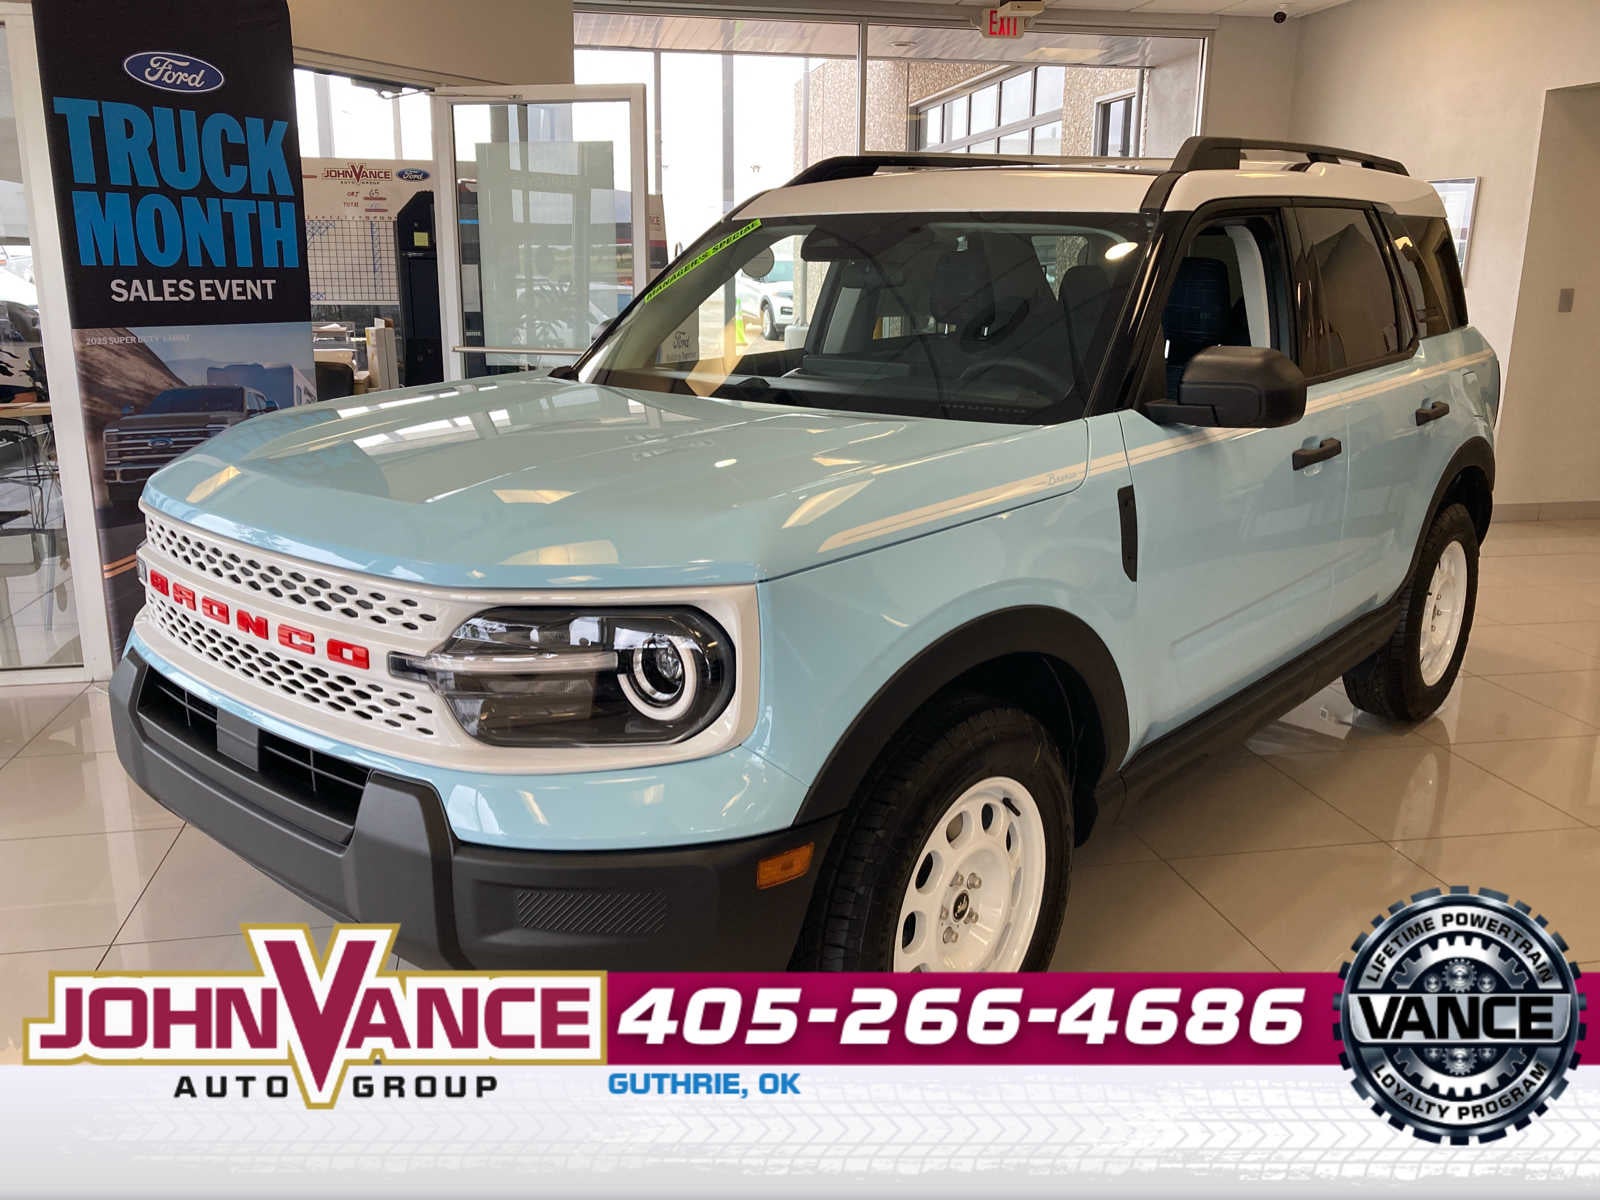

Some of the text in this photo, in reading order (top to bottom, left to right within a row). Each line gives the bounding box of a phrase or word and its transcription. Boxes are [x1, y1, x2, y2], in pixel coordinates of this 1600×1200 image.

[53, 96, 295, 196] TRUCK
[324, 164, 391, 182] JOHN VANCE
[71, 190, 299, 268] MONTH
[711, 222, 755, 253] SPECIAL
[110, 278, 277, 302] SALES EVENT
[86, 337, 108, 346] 2025
[109, 336, 137, 345] SUPER
[150, 569, 370, 670] BRONCO
